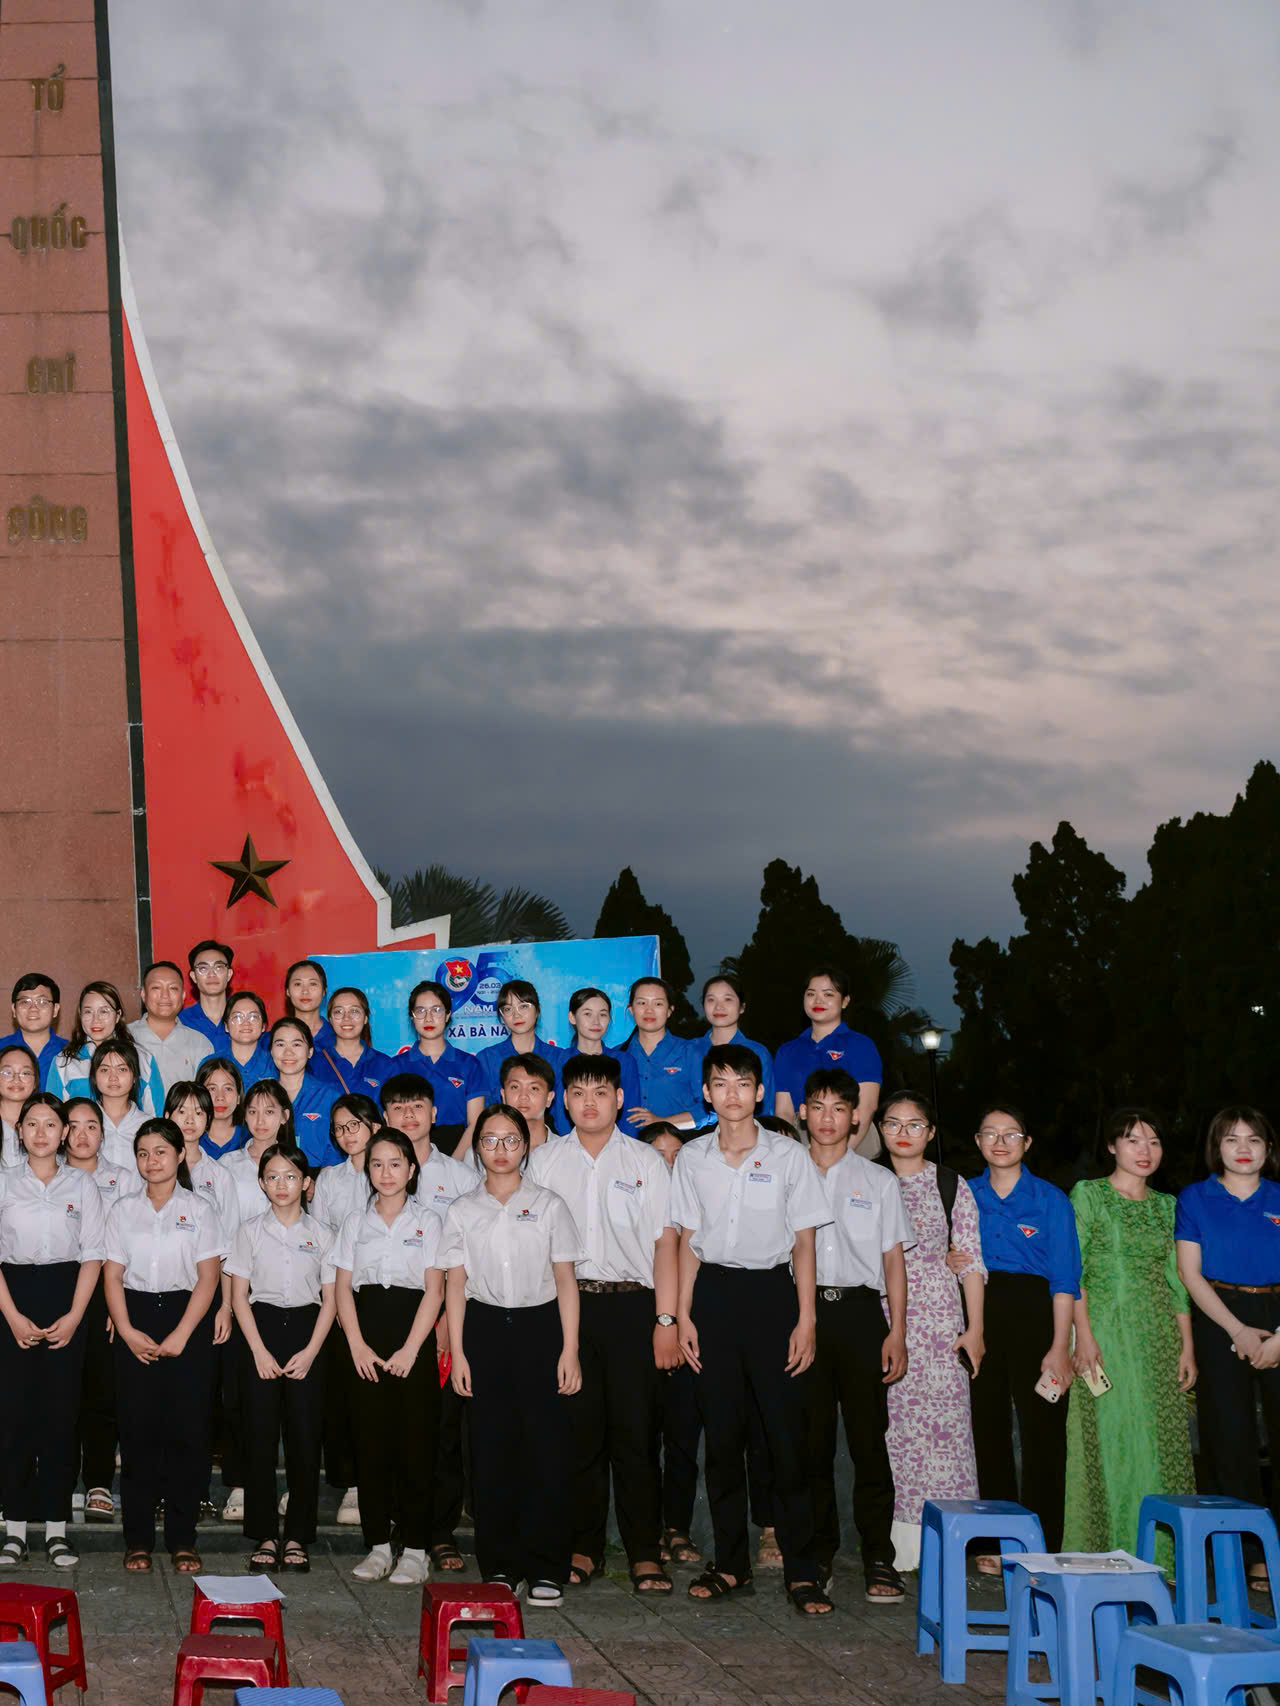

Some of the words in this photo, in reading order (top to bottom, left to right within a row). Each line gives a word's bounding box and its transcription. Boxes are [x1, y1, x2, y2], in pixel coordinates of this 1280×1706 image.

[31, 64, 65, 111] TỔ
[11, 203, 87, 251] QUỐC
[8, 495, 88, 542] CÔNG
[479, 982, 502, 990] 26.03
[464, 1003, 493, 1013] NĂM
[448, 1024, 466, 1038] XÃ
[470, 1023, 487, 1037] BÀ
